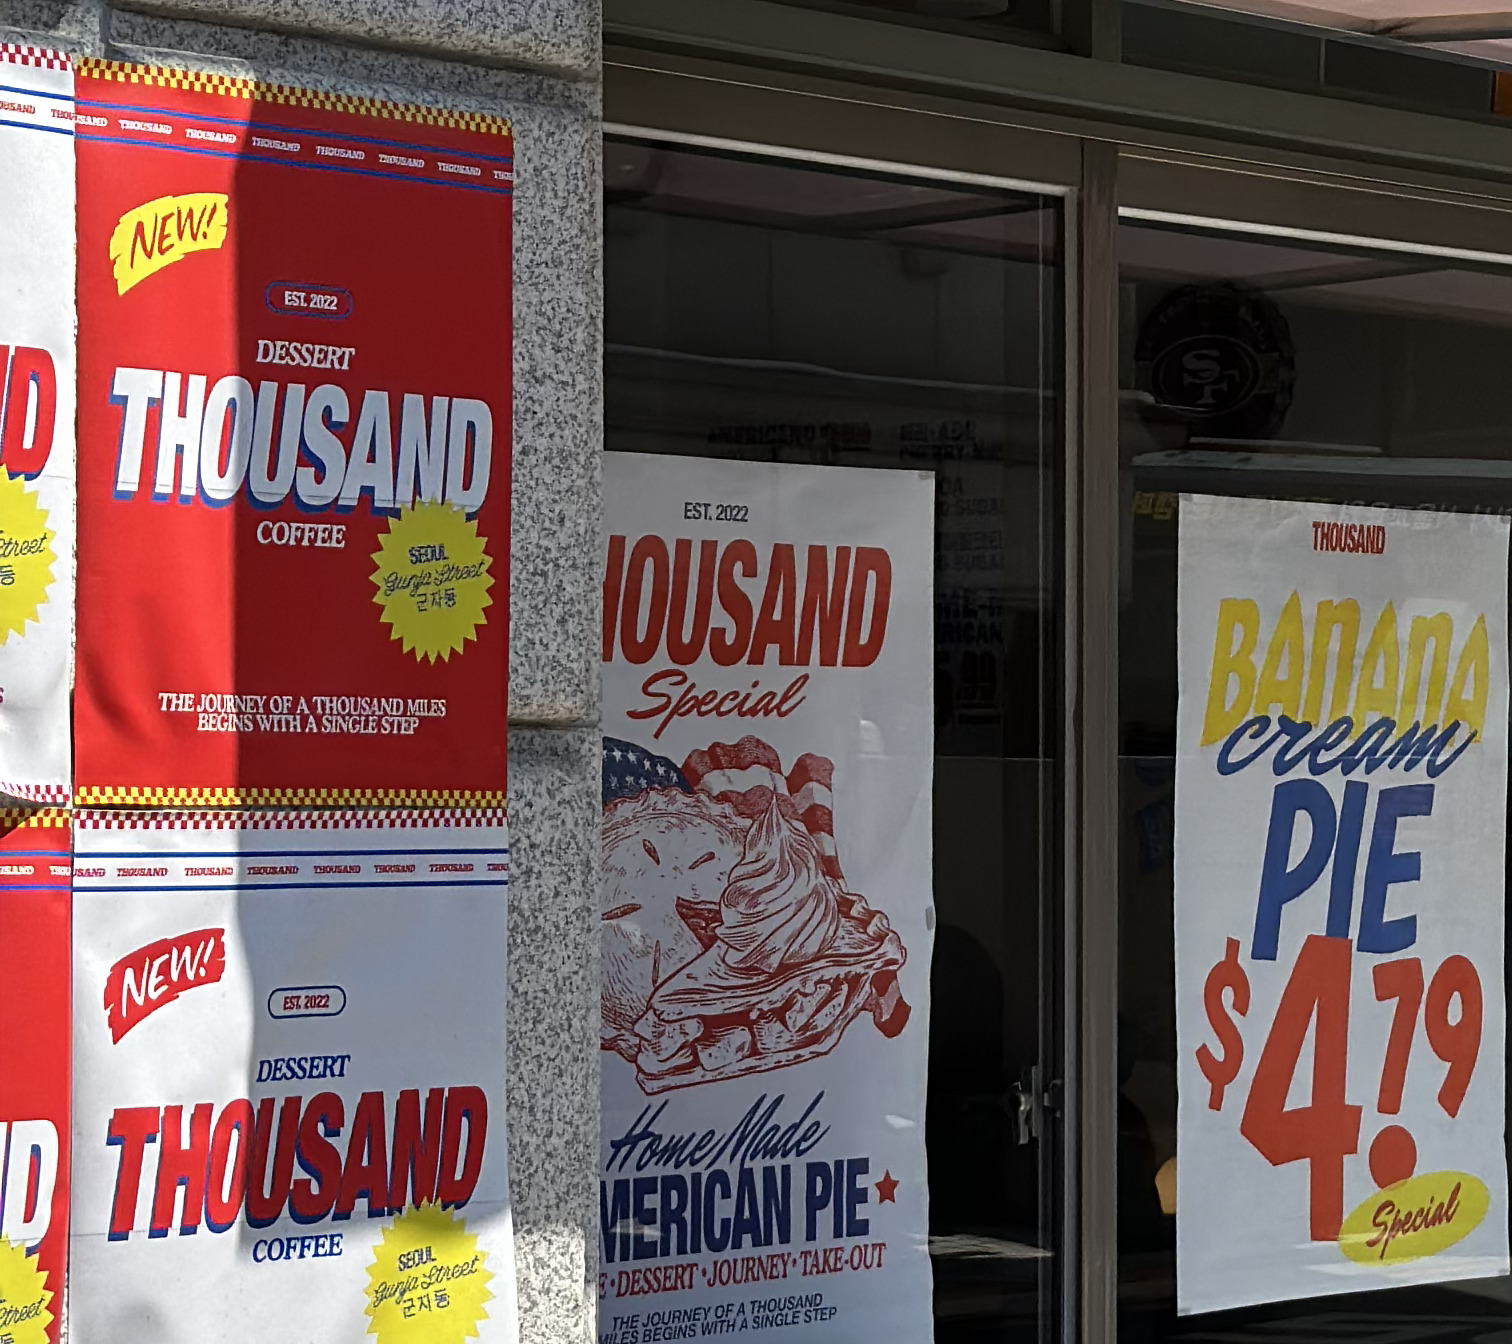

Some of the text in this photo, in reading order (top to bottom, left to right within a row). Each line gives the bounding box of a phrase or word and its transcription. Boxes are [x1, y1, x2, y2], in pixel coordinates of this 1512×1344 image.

[118, 119, 172, 134] THOUSAND
[185, 128, 237, 144] THOUSAND
[252, 137, 300, 152] THOUSAND
[316, 145, 365, 160] THOUSAND
[130, 202, 217, 269] NEW!
[284, 290, 338, 310] EST. 2022
[256, 339, 355, 370] DESSERT
[110, 366, 494, 519] THOUSAND
[683, 502, 749, 522] EST. 2022
[256, 520, 346, 550] COFFEE
[408, 544, 449, 564] SEOUL
[1312, 521, 1386, 554] THOUSAND
[602, 534, 892, 668] HOUSAND
[158, 692, 447, 717] THE JOURNEY OF A THOUSAND MILES
[626, 668, 810, 739] Special
[197, 713, 420, 735] BEGINS WITH A SINGLE STEP
[1217, 712, 1481, 778] cream
[117, 867, 169, 877] THOUSAND
[184, 866, 233, 877] THOUSAND
[247, 865, 299, 876] THOUSAND
[313, 865, 361, 874] THOUSAND
[1251, 775, 1435, 961] PIE
[121, 936, 215, 1018] NEW!
[303, 994, 330, 1010] 2022
[256, 1054, 351, 1083] DESSERT
[106, 1085, 488, 1242] THOUSAND
[600, 1157, 869, 1264] MERICAN PIE
[1365, 1181, 1461, 1260] Special
[252, 1232, 344, 1264] COFFEE
[398, 1245, 437, 1272] SEOUL
[616, 1263, 698, 1298] DESSERT
[706, 1252, 791, 1288] JOURNEY
[800, 1242, 887, 1277] TAKE-OUT
[612, 1293, 823, 1331] THE JOURNEY OF A THOUSAND
[642, 1324, 696, 1344] BEGINS
[701, 1319, 735, 1337] WITH
[739, 1318, 748, 1331] A
[752, 1311, 801, 1330] SINGLE
[804, 1306, 838, 1323] STEP
